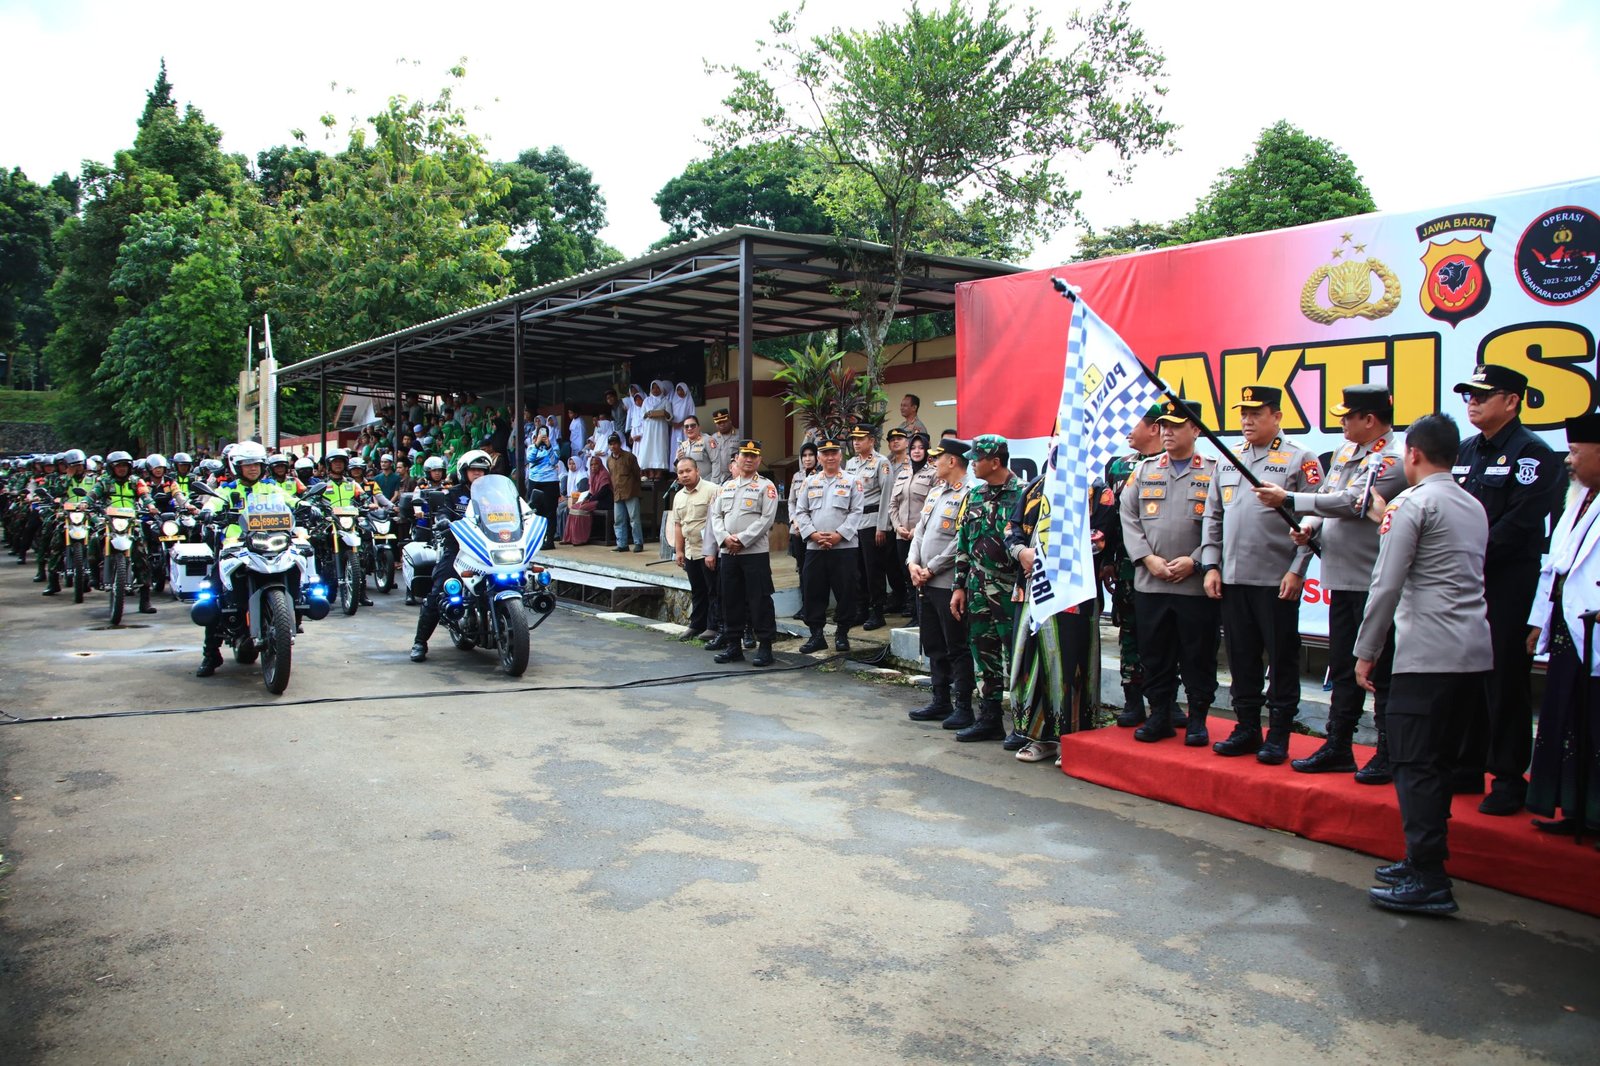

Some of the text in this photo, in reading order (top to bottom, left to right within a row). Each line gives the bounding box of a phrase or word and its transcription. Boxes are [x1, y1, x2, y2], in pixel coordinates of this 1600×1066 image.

[1422, 218, 1490, 237] JAWA BARAT
[1542, 212, 1584, 228] OPERASI
[1521, 260, 1600, 300] NUSANTARA COOLING SYSTE
[1154, 321, 1600, 436] AKTI S
[1264, 465, 1287, 473] POLRI
